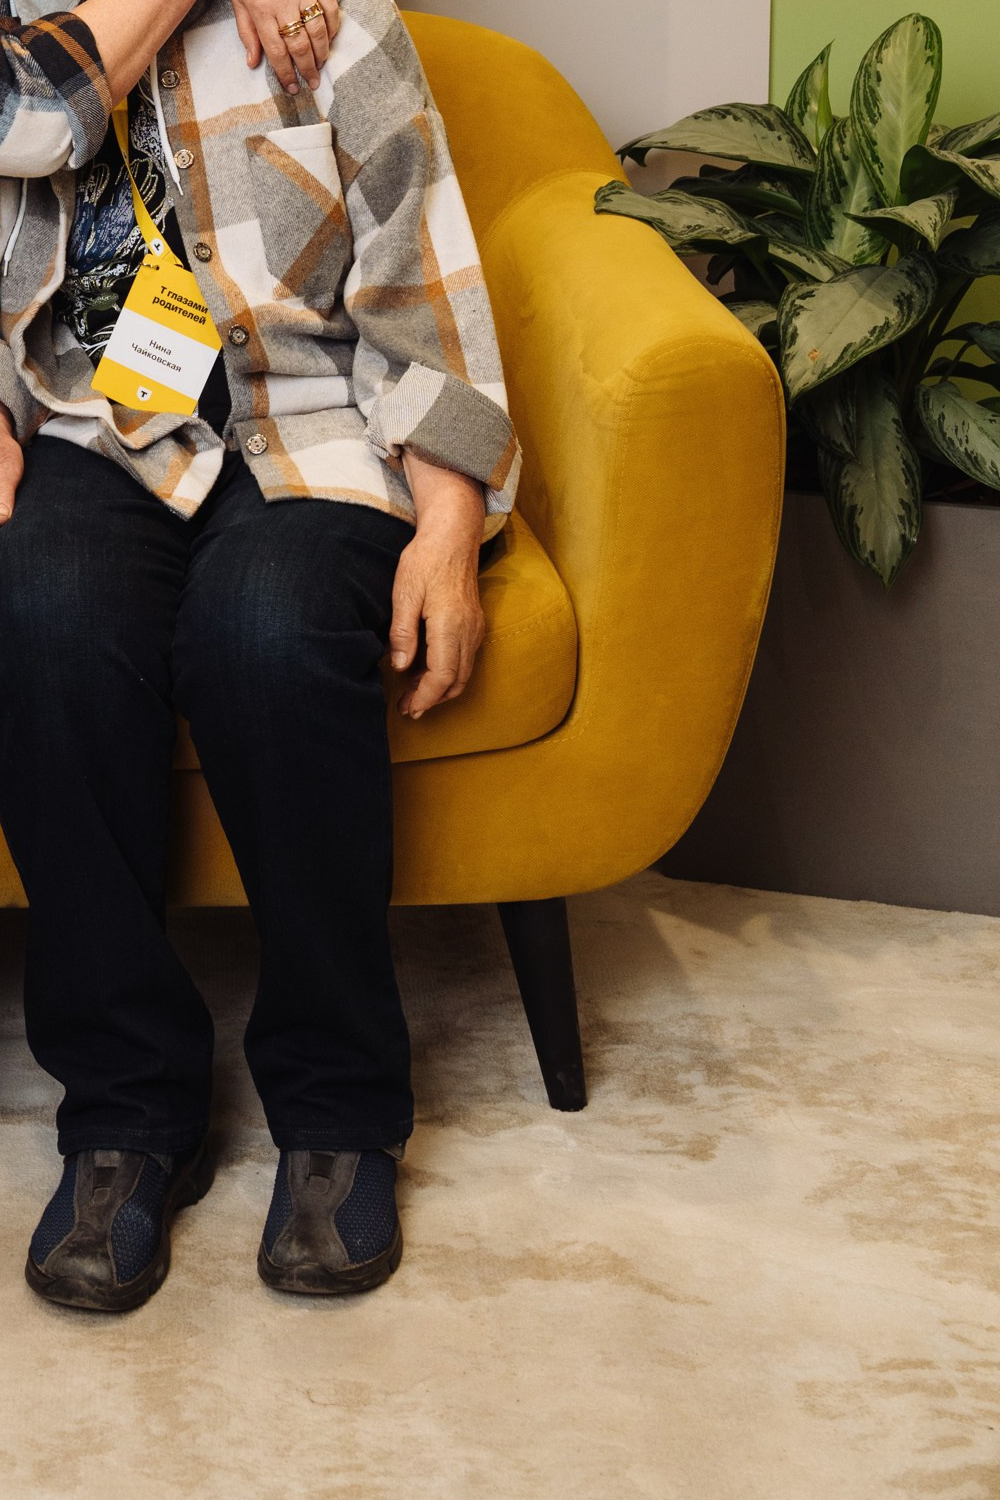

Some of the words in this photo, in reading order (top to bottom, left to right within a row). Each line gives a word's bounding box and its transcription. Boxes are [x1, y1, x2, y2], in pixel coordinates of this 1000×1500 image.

[152, 296, 207, 325] родителей
[160, 285, 168, 295] Т
[166, 290, 209, 314] глазами
[131, 342, 182, 373] Чайковская
[149, 339, 172, 356] Нина
